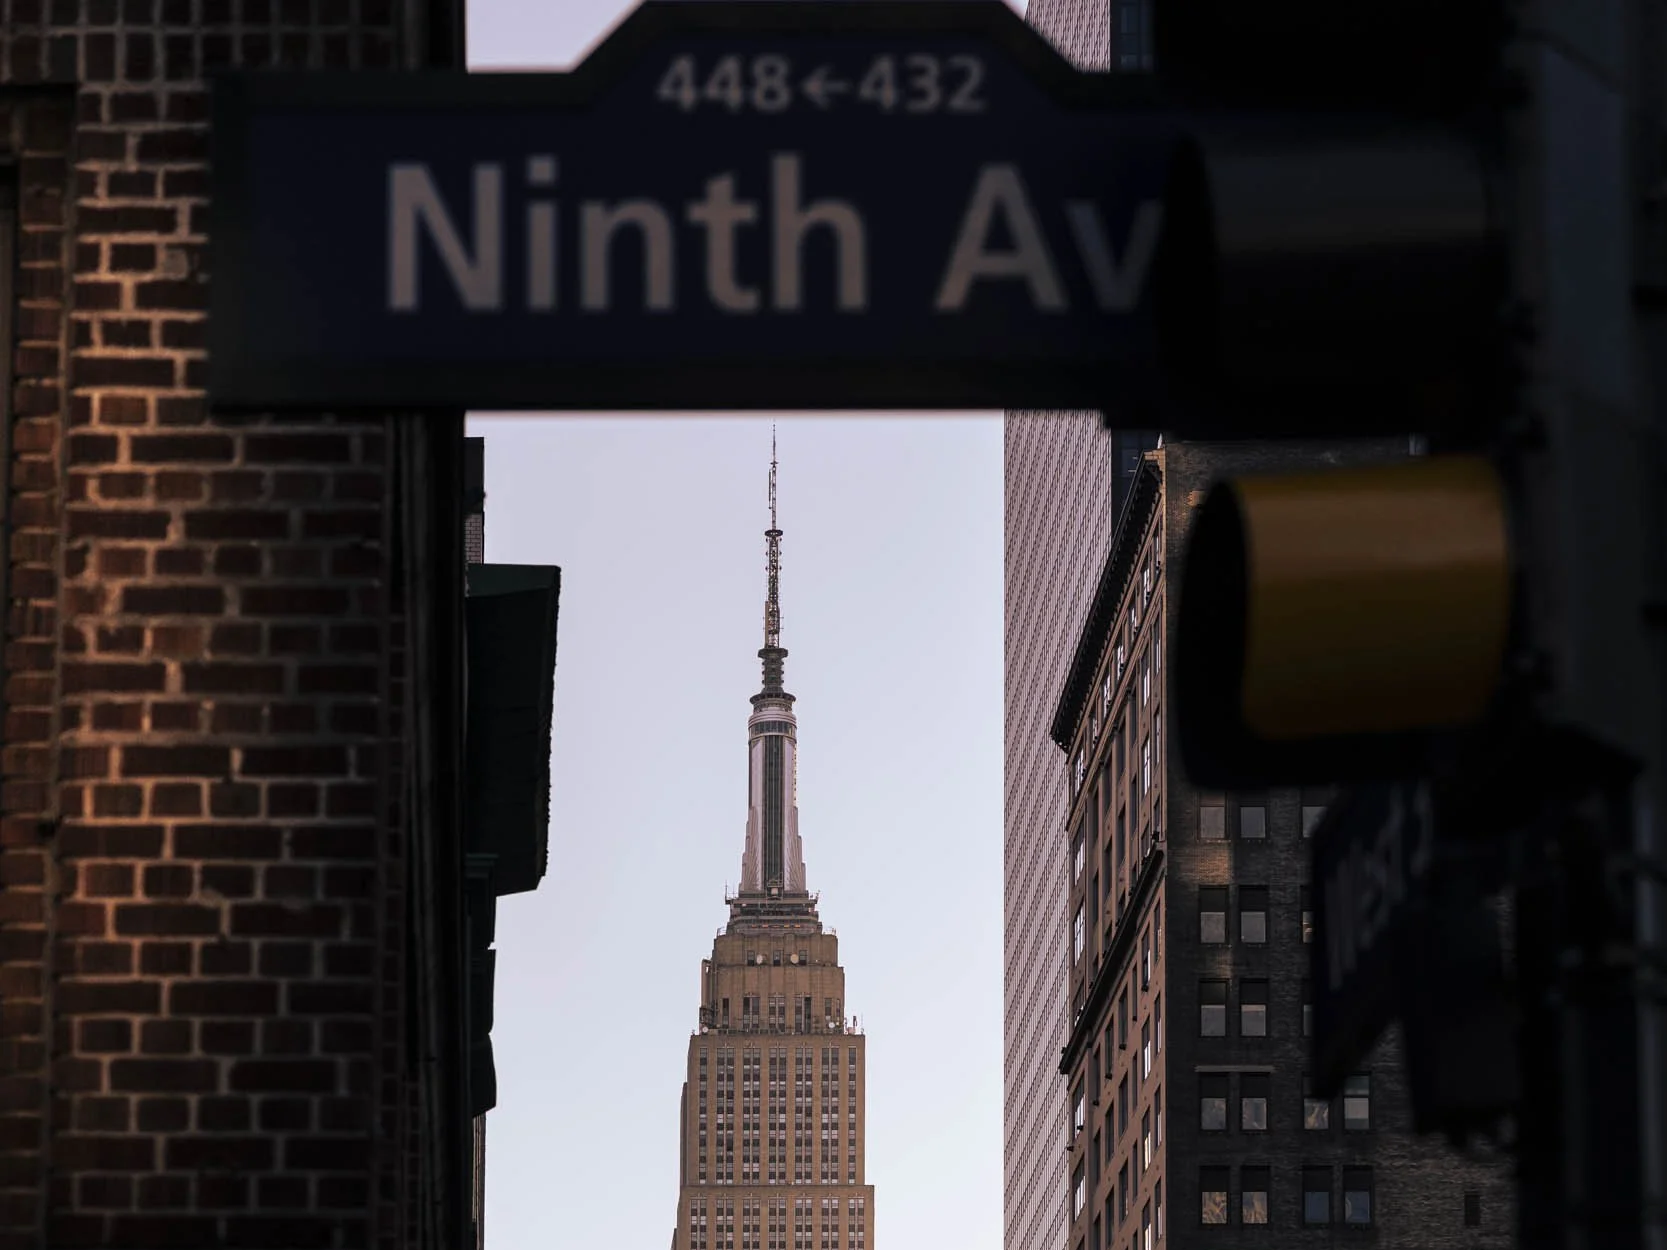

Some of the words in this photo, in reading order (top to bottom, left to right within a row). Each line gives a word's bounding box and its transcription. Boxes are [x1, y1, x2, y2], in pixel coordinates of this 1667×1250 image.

[657, 54, 793, 113] 448
[857, 55, 987, 113] 432
[386, 152, 869, 312] Ninth
